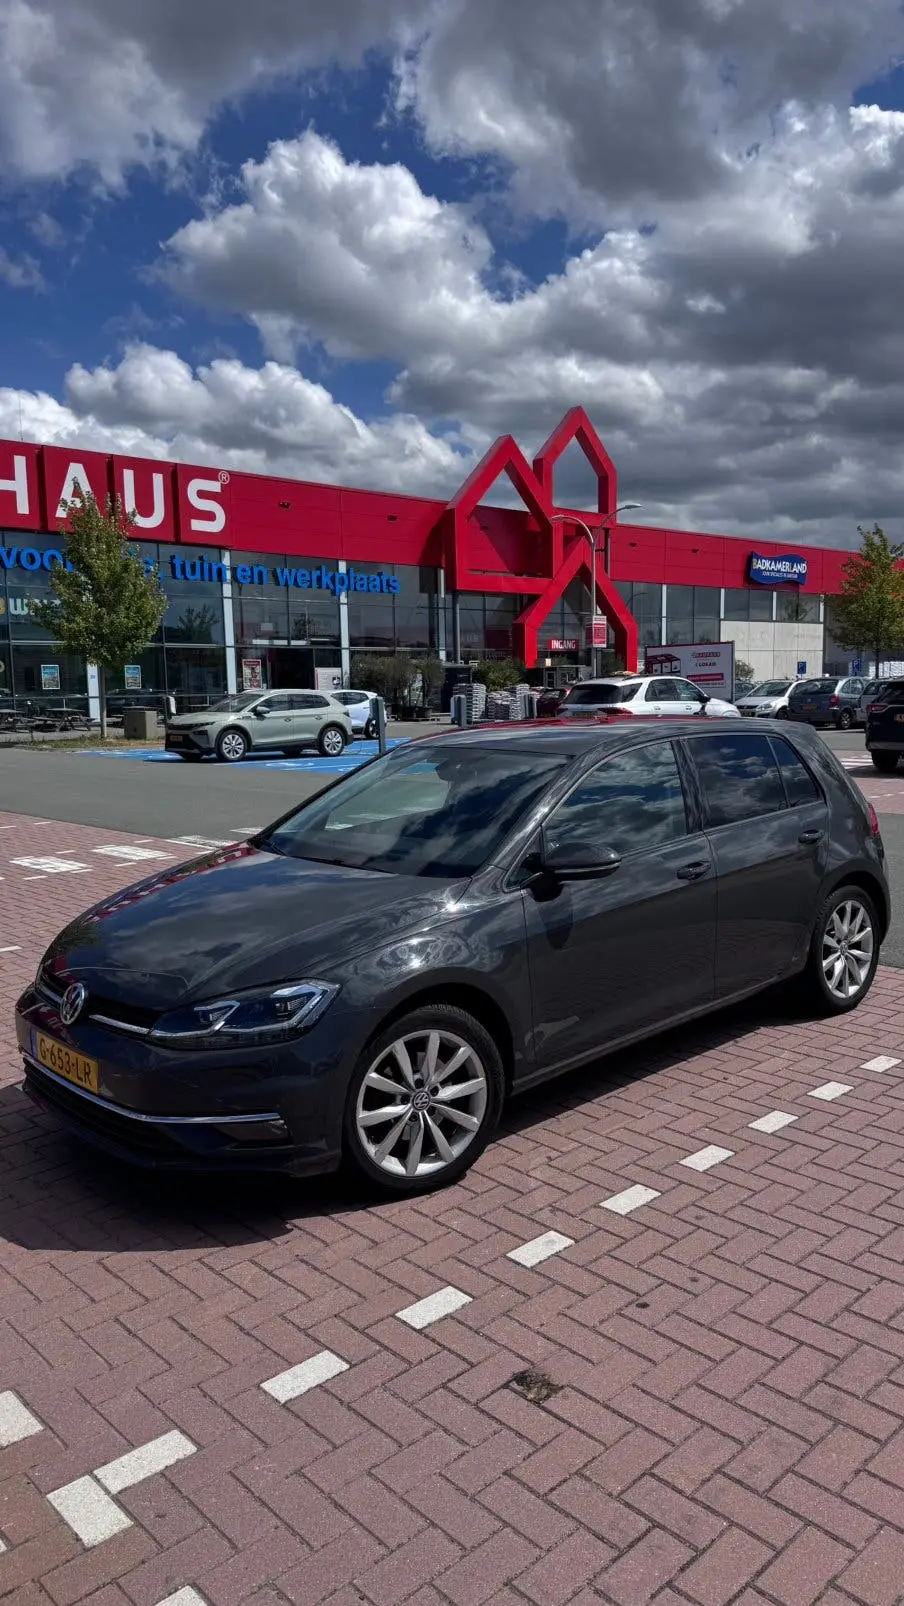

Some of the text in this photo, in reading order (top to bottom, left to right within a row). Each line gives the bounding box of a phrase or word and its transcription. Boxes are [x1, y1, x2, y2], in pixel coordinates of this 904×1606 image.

[172, 555, 227, 583] tuin
[236, 563, 268, 585] en
[275, 565, 400, 596] werkplaats
[752, 558, 808, 574] BADKAMERLAND
[551, 639, 576, 649] INGANG
[39, 1038, 92, 1087] G-653-LR
